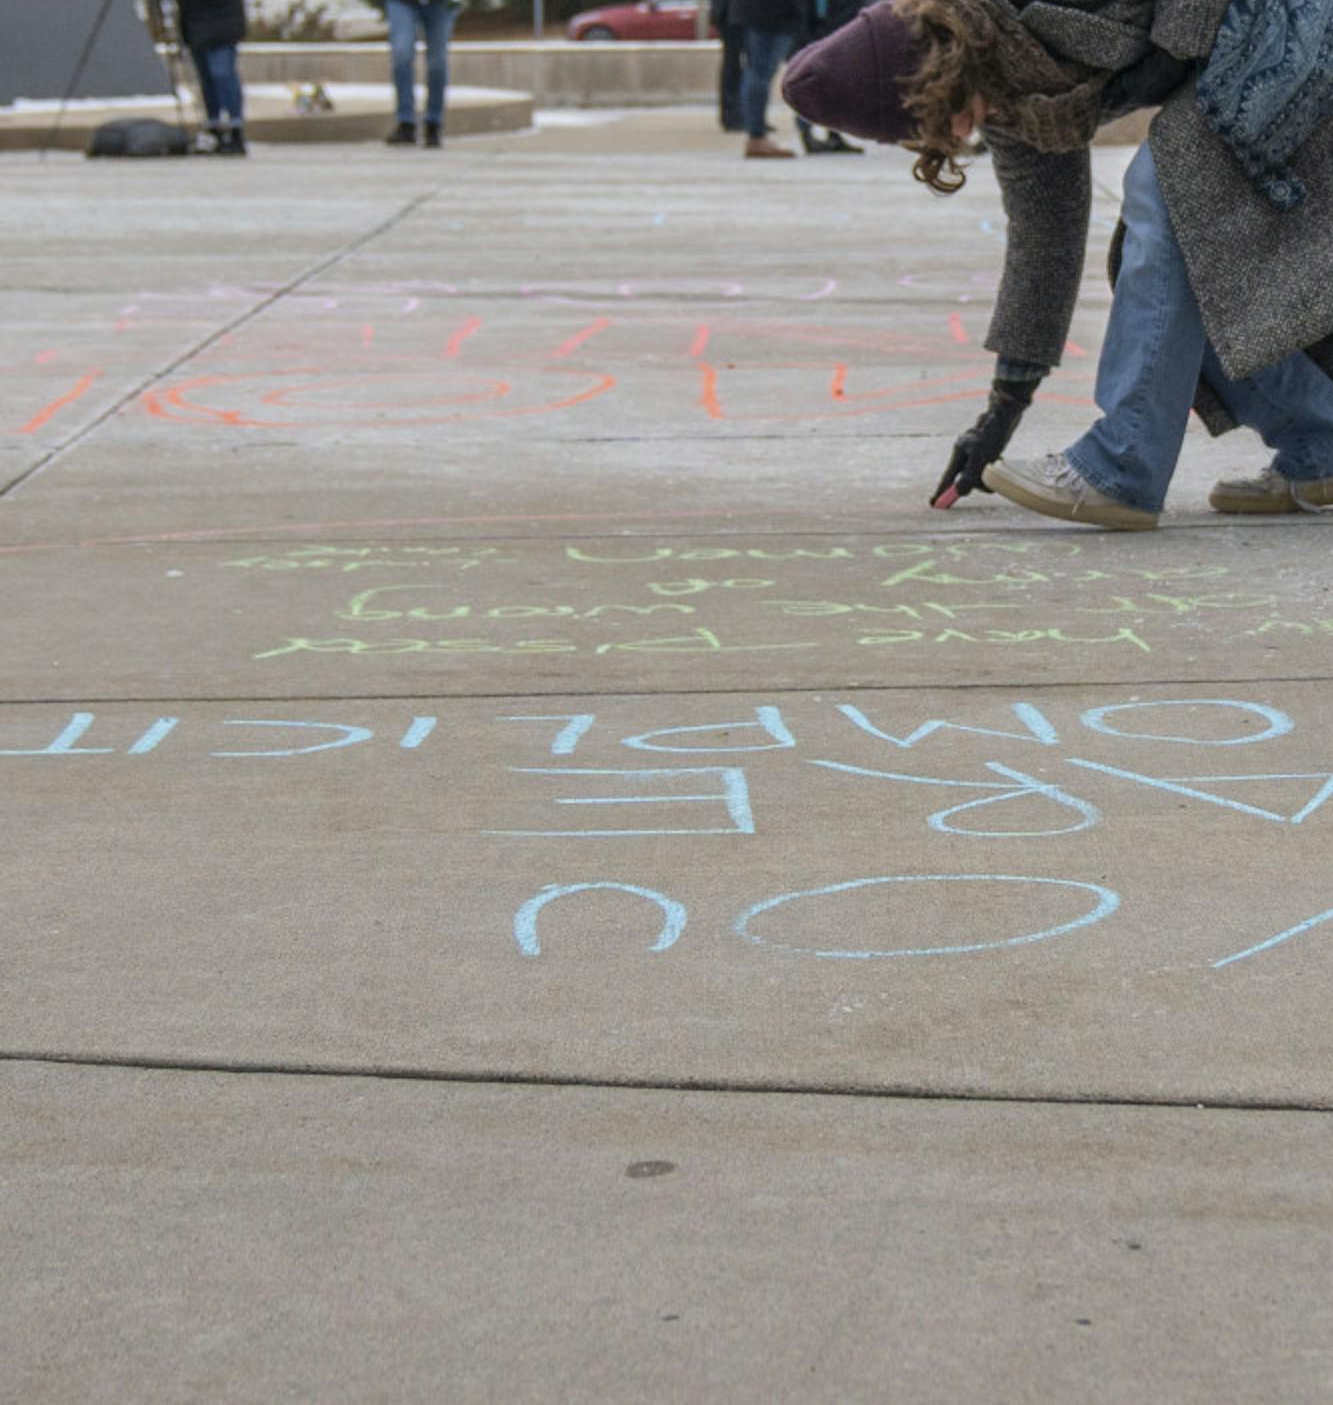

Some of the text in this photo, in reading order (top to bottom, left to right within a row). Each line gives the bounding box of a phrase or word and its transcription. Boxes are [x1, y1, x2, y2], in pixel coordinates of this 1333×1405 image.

[566, 542, 1082, 562] women
[648, 560, 1230, 595] army of
[333, 585, 696, 619] wrong
[755, 599, 1022, 619] the
[253, 626, 820, 659] pissed
[858, 627, 1150, 652] have
